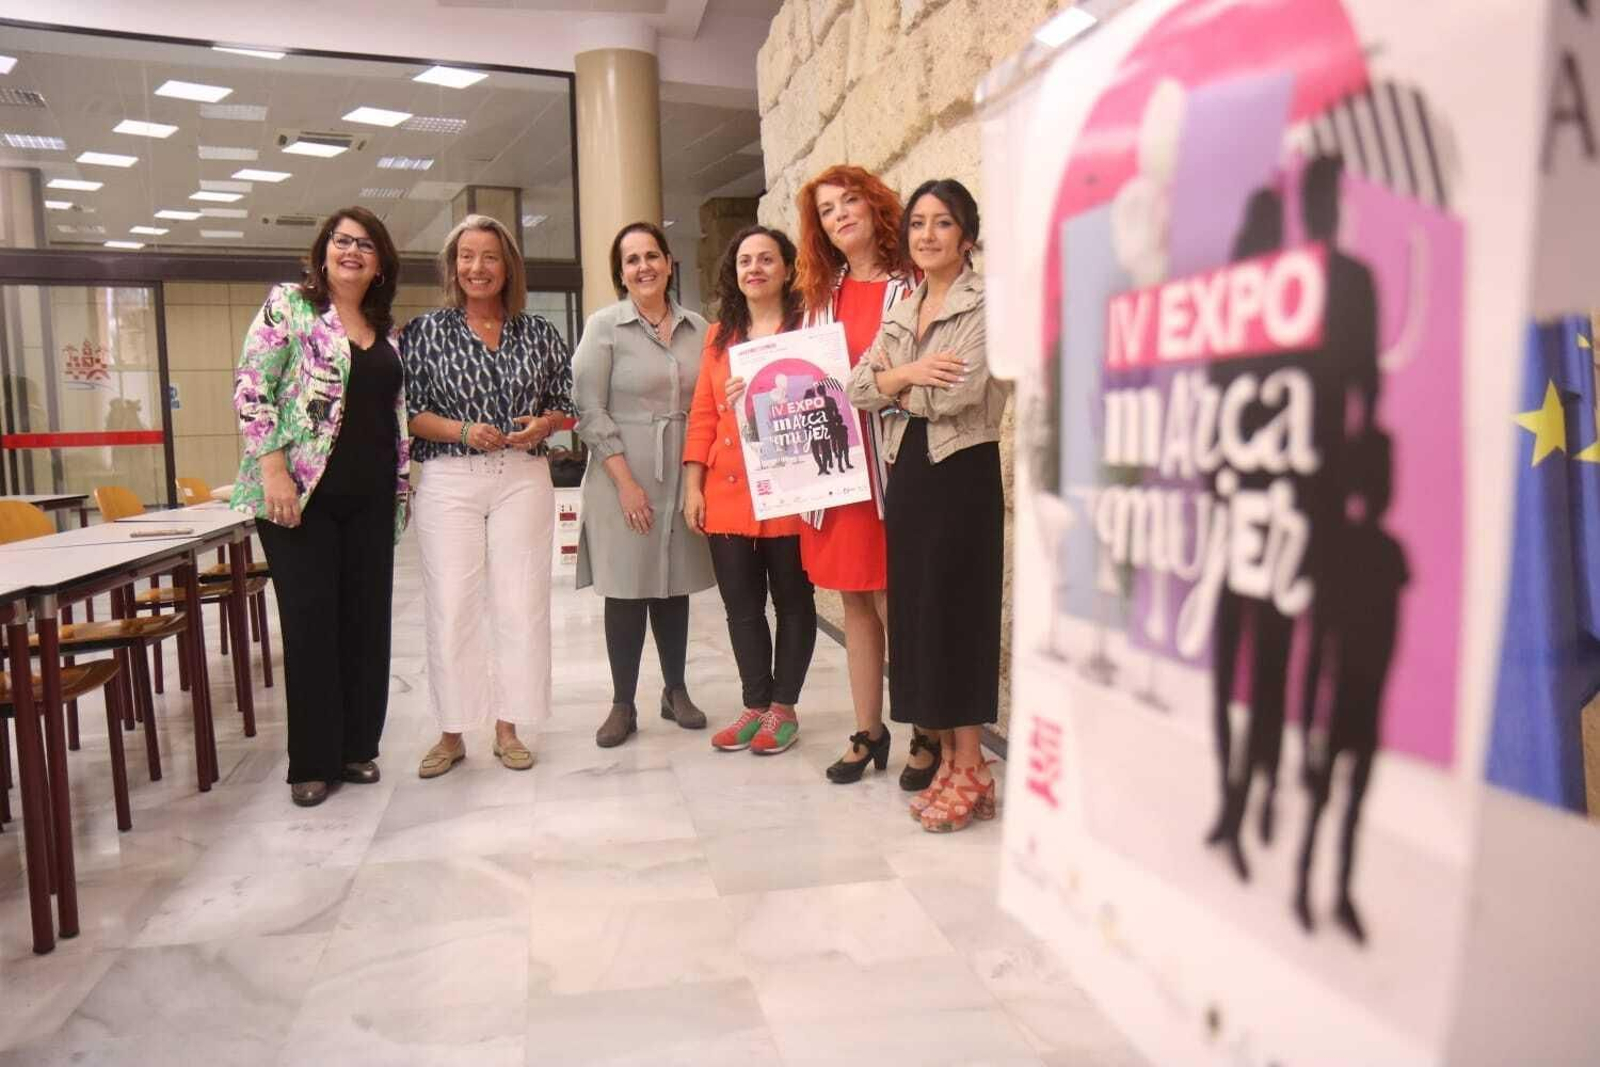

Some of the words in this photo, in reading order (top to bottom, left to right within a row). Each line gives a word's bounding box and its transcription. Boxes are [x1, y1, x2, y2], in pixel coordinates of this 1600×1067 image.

[1108, 293, 1153, 365] IV
[1157, 249, 1326, 360] EXPO
[771, 403, 786, 418] IV
[787, 396, 825, 414] EXPO
